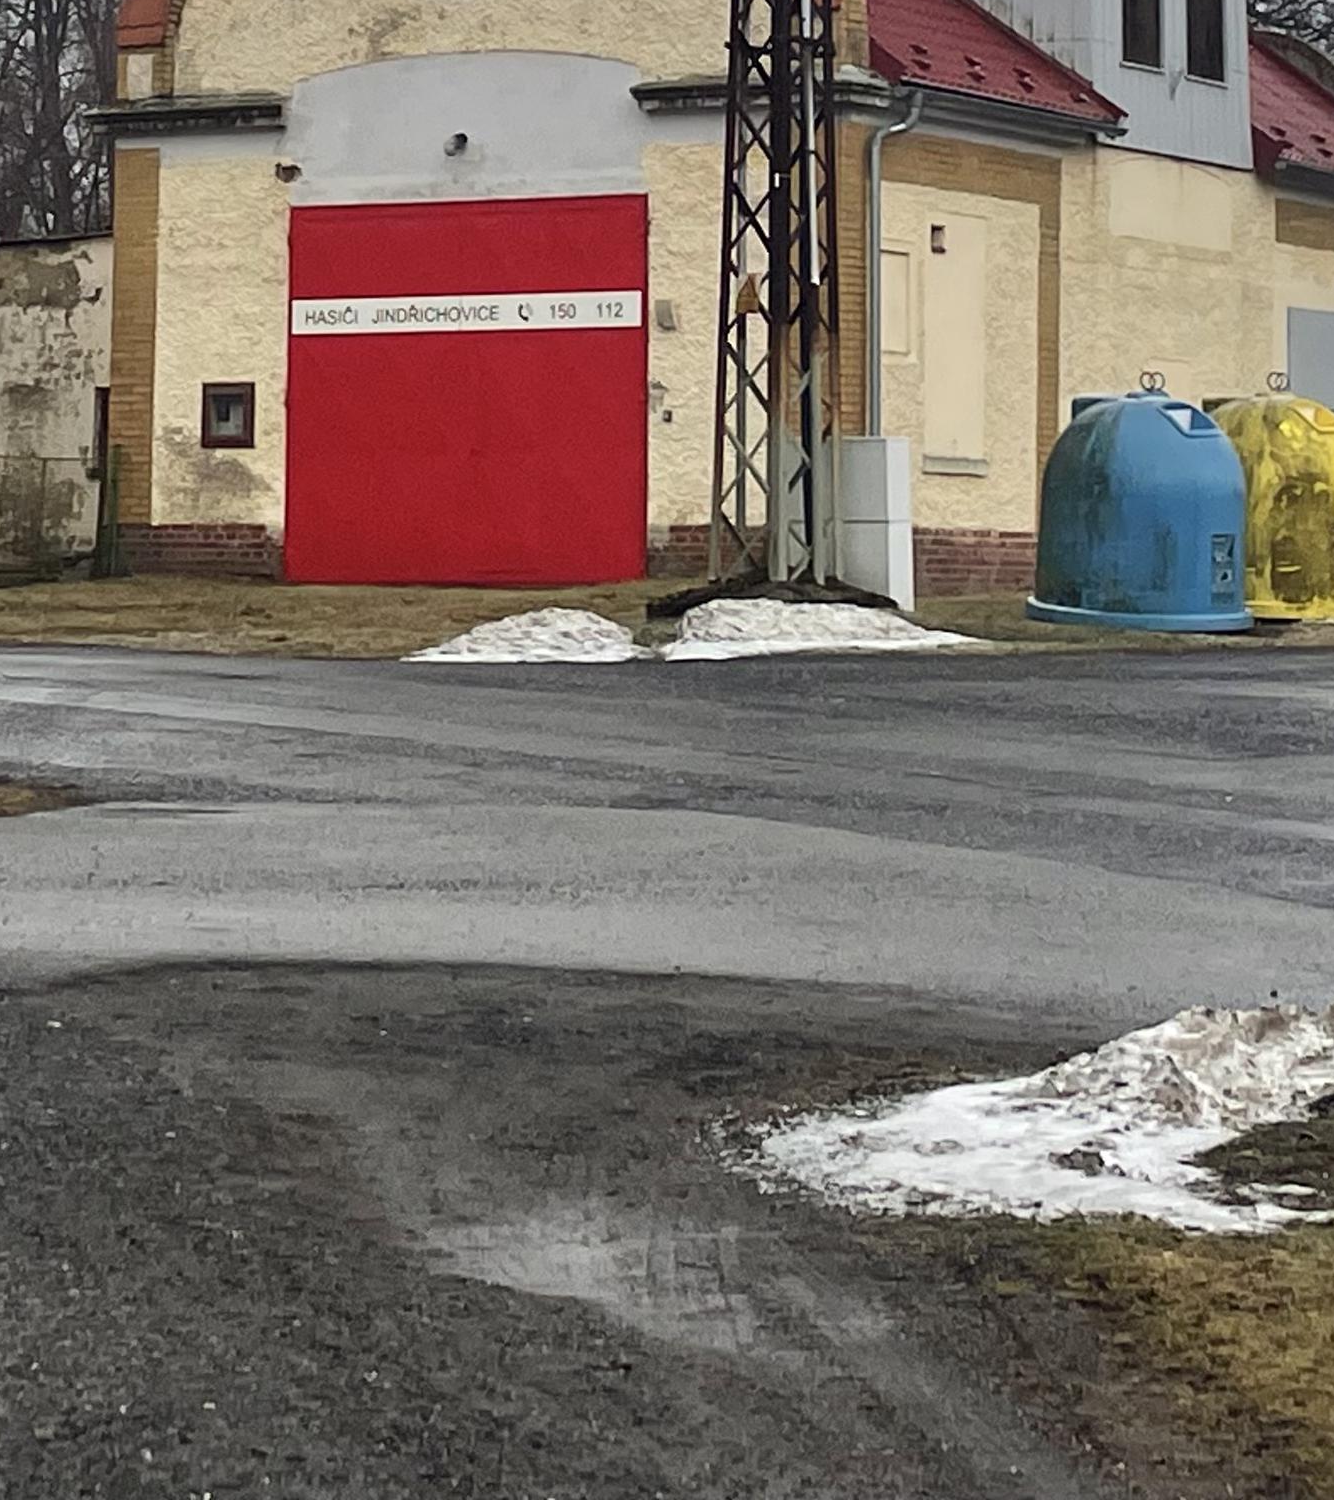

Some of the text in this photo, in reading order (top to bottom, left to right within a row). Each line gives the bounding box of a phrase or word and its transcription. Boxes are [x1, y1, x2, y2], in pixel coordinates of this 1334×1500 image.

[305, 302, 623, 325] HASIČI JINDŘICHOVICE 150 112
